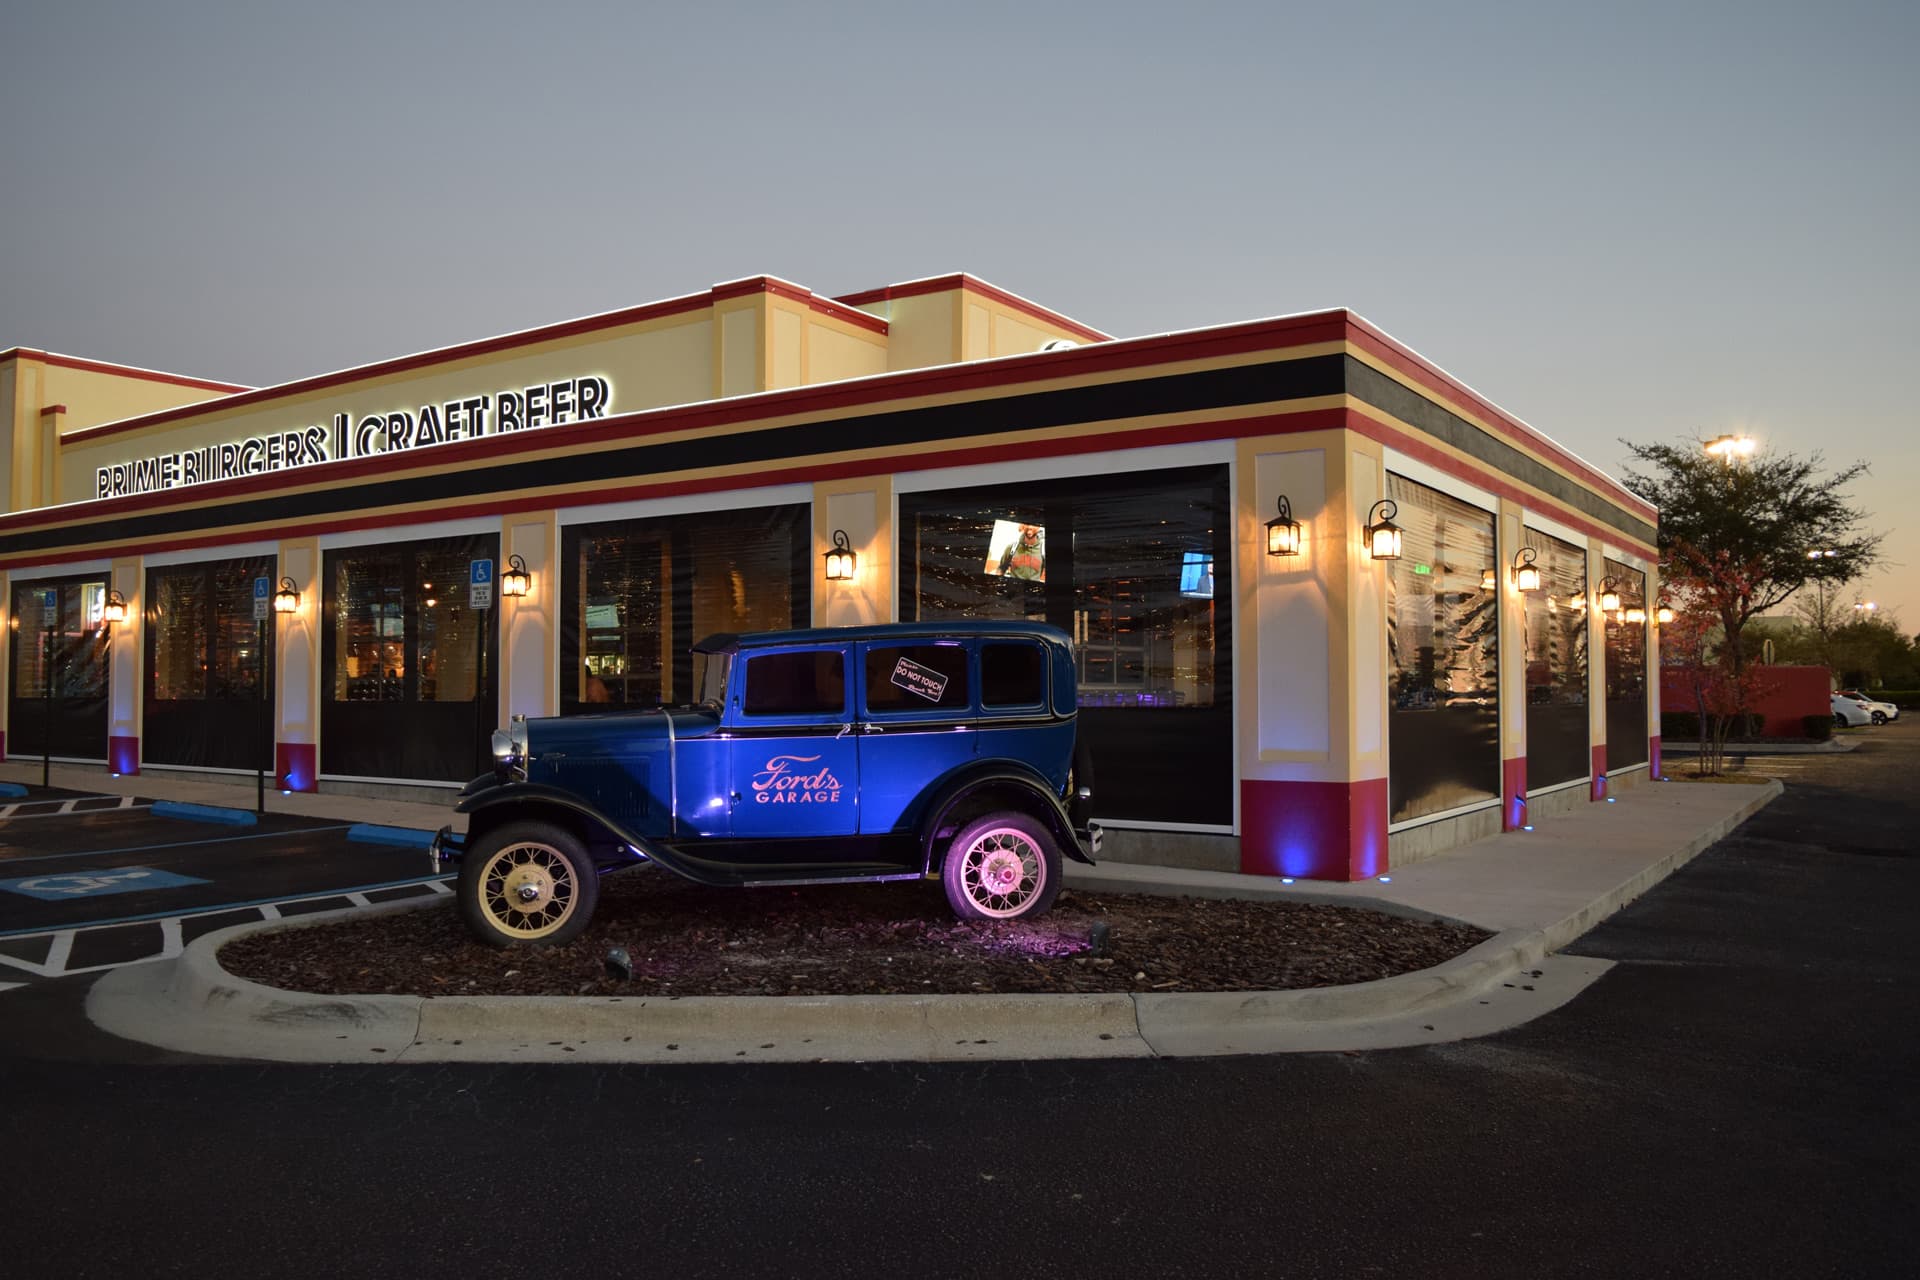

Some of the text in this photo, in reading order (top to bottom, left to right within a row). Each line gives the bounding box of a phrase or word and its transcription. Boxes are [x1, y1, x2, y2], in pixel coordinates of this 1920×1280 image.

[96, 453, 179, 499] PRIME
[183, 426, 327, 485] BURGERS
[355, 395, 490, 456] CRAFT
[496, 376, 609, 433] BEER
[896, 666, 907, 675] DO
[907, 671, 921, 681] NOT
[921, 676, 943, 690] TOUCH
[751, 754, 844, 791] Ford's
[755, 791, 840, 804] GARAGE
